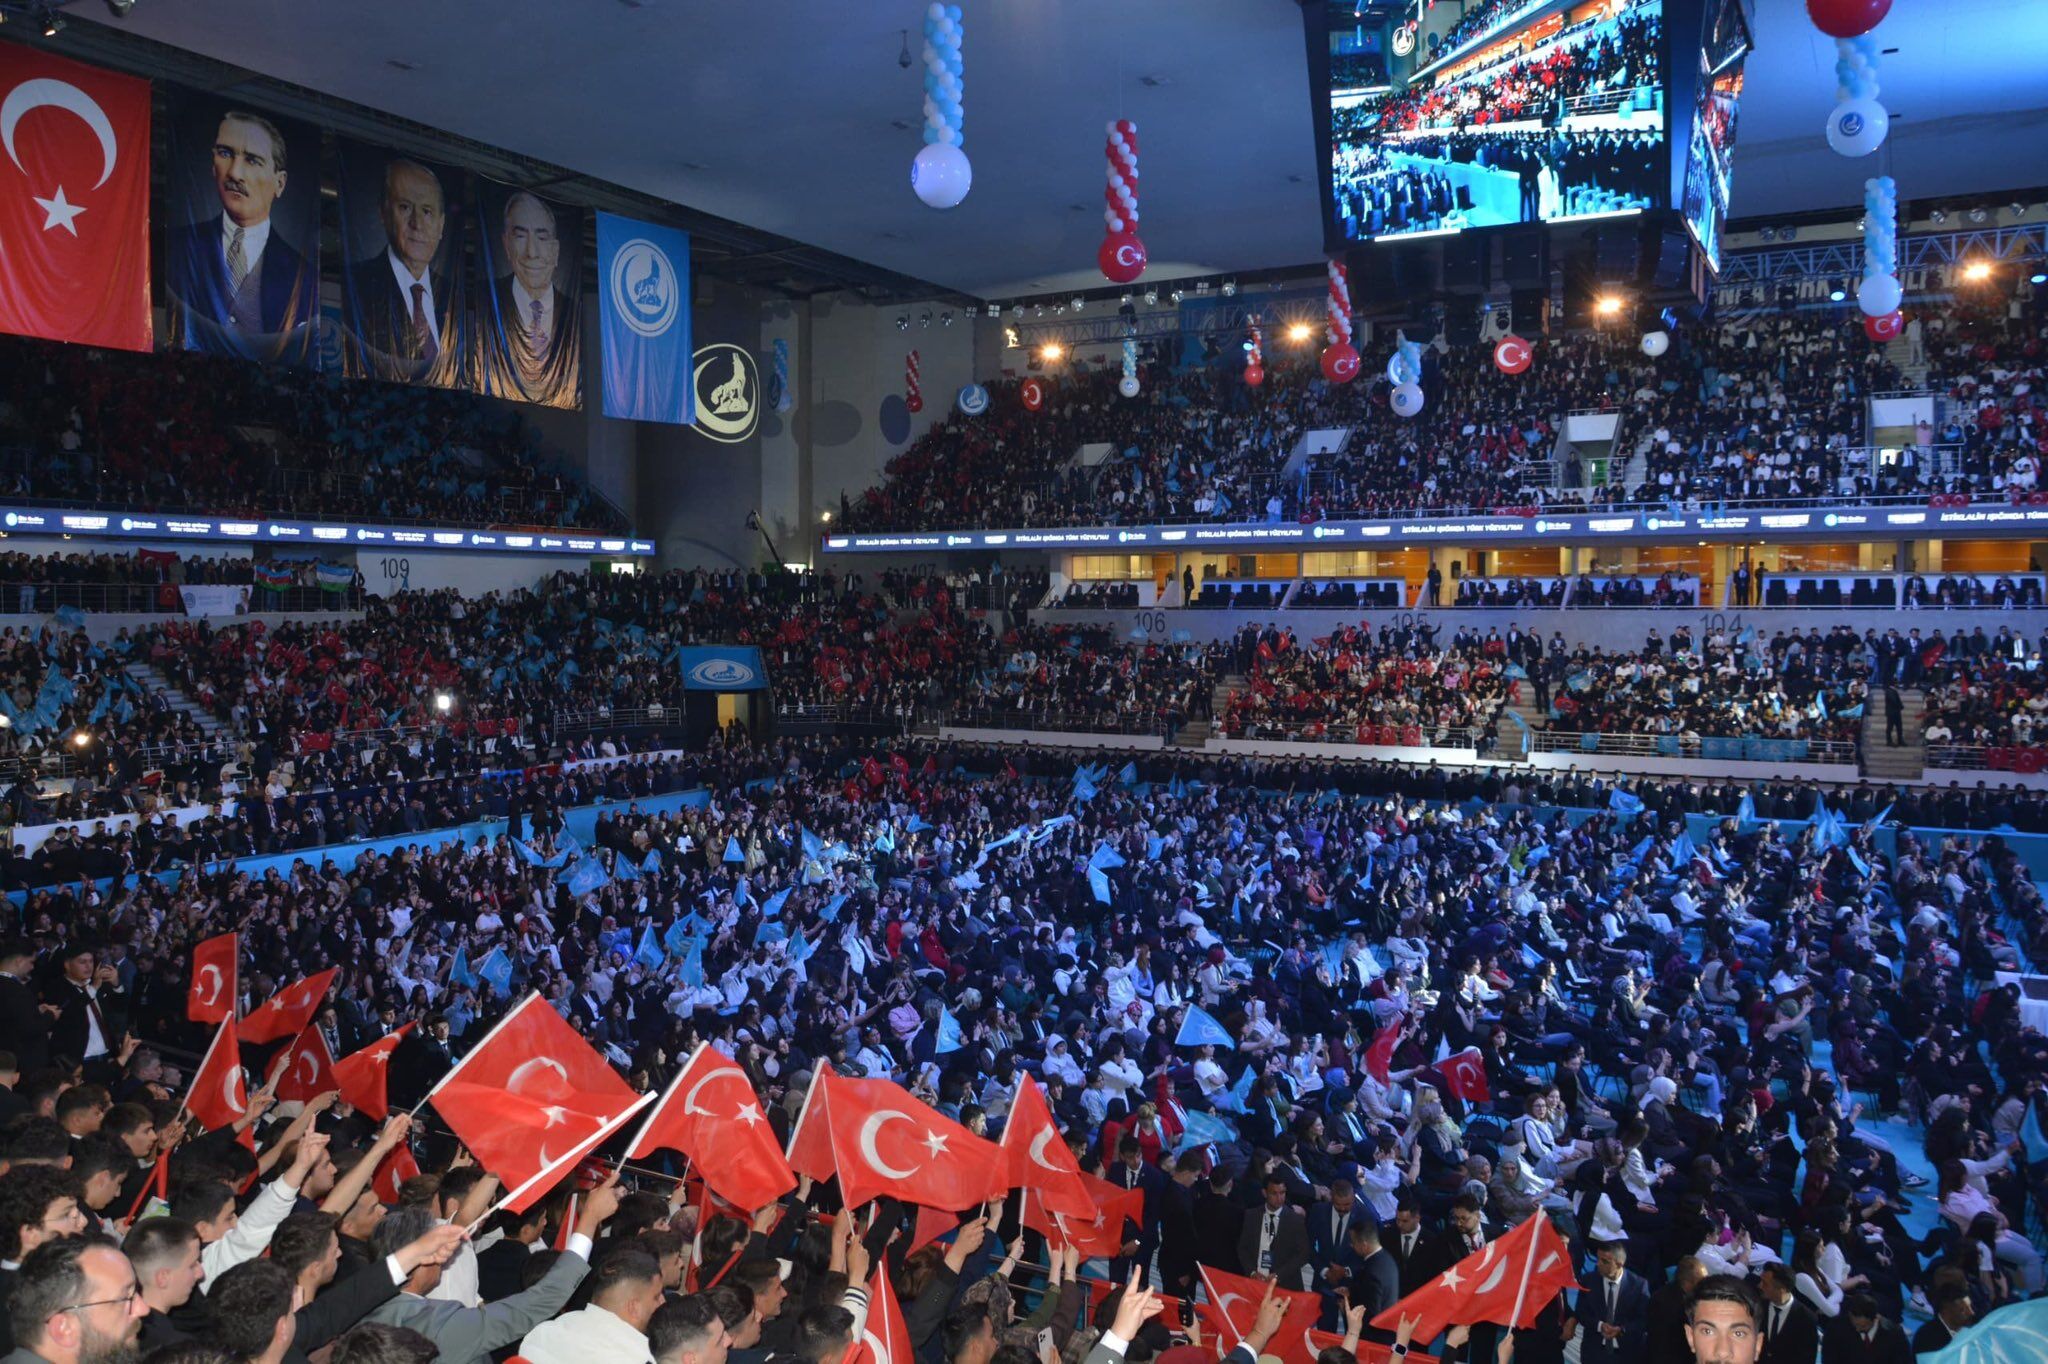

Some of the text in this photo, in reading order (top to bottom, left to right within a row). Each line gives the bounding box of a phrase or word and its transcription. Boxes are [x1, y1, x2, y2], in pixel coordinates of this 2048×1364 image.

[380, 558, 410, 579] 109
[1134, 611, 1166, 633] 106
[1699, 613, 1742, 634] 104
